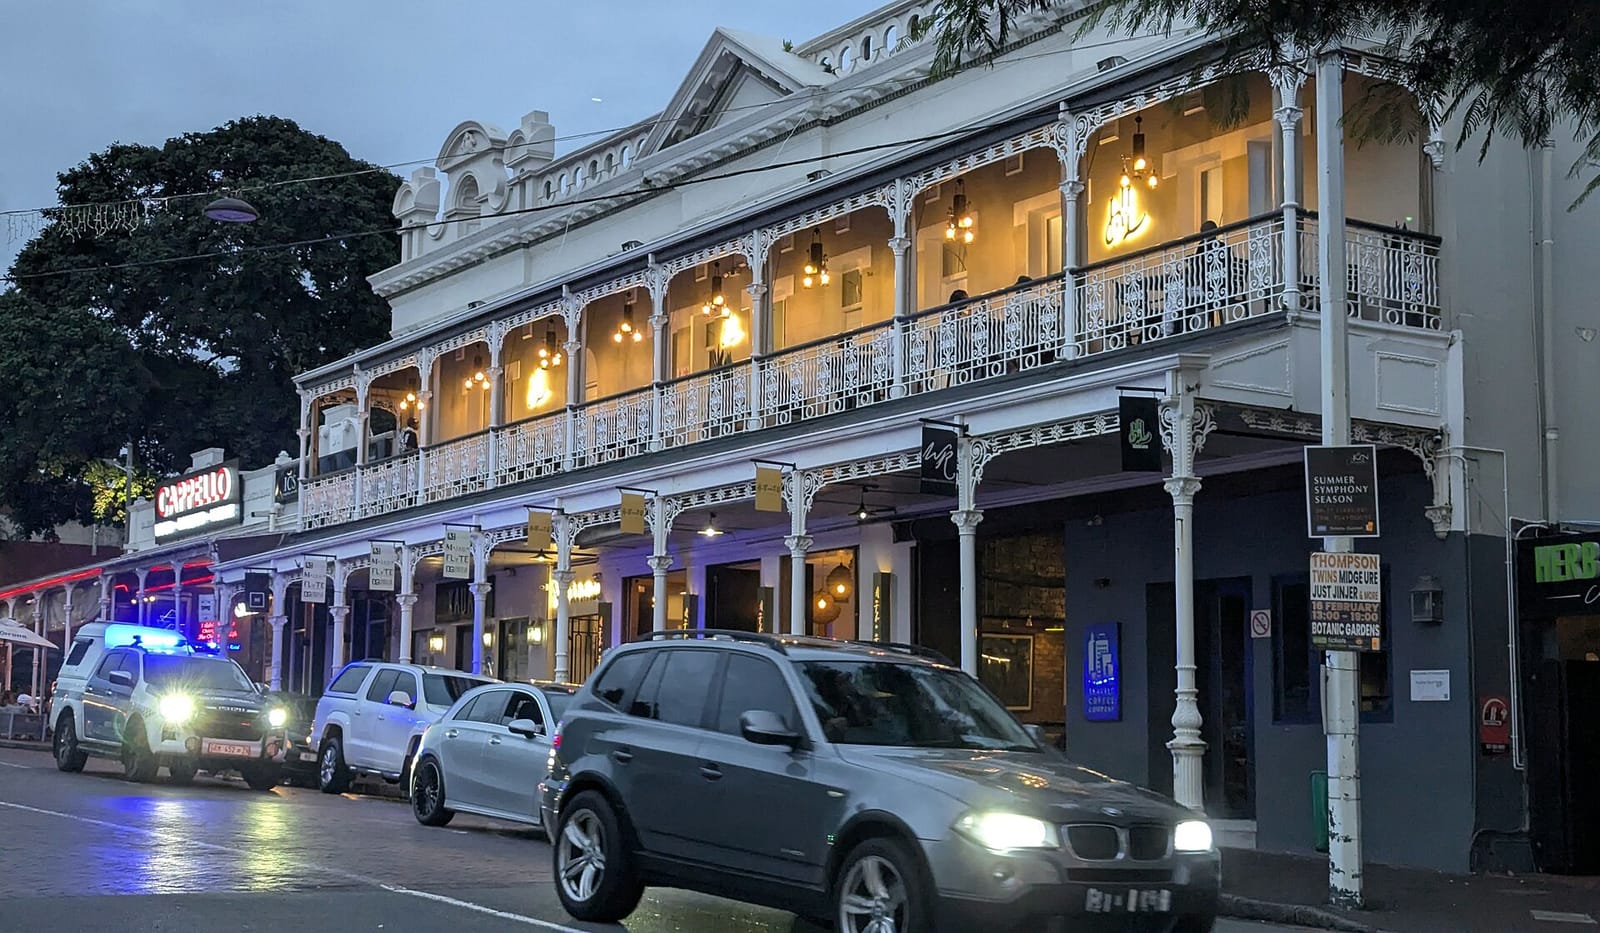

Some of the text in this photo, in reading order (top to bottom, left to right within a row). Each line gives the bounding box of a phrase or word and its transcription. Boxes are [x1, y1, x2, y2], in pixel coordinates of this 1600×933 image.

[1314, 476, 1355, 485] SUMMER
[157, 467, 232, 517] CAPPELLO
[1314, 485, 1368, 494] SYMPHONY
[1314, 495, 1353, 504] SEASON
[1312, 555, 1378, 569] THOMPSON
[1535, 542, 1600, 583] HERB
[1312, 570, 1378, 584] TWINS MIDGE URE
[1312, 585, 1331, 598] JUST
[1333, 586, 1358, 599] JINJER
[1325, 602, 1379, 612] FEBRUARY
[1312, 622, 1380, 636] BOTANIC GARDENS
